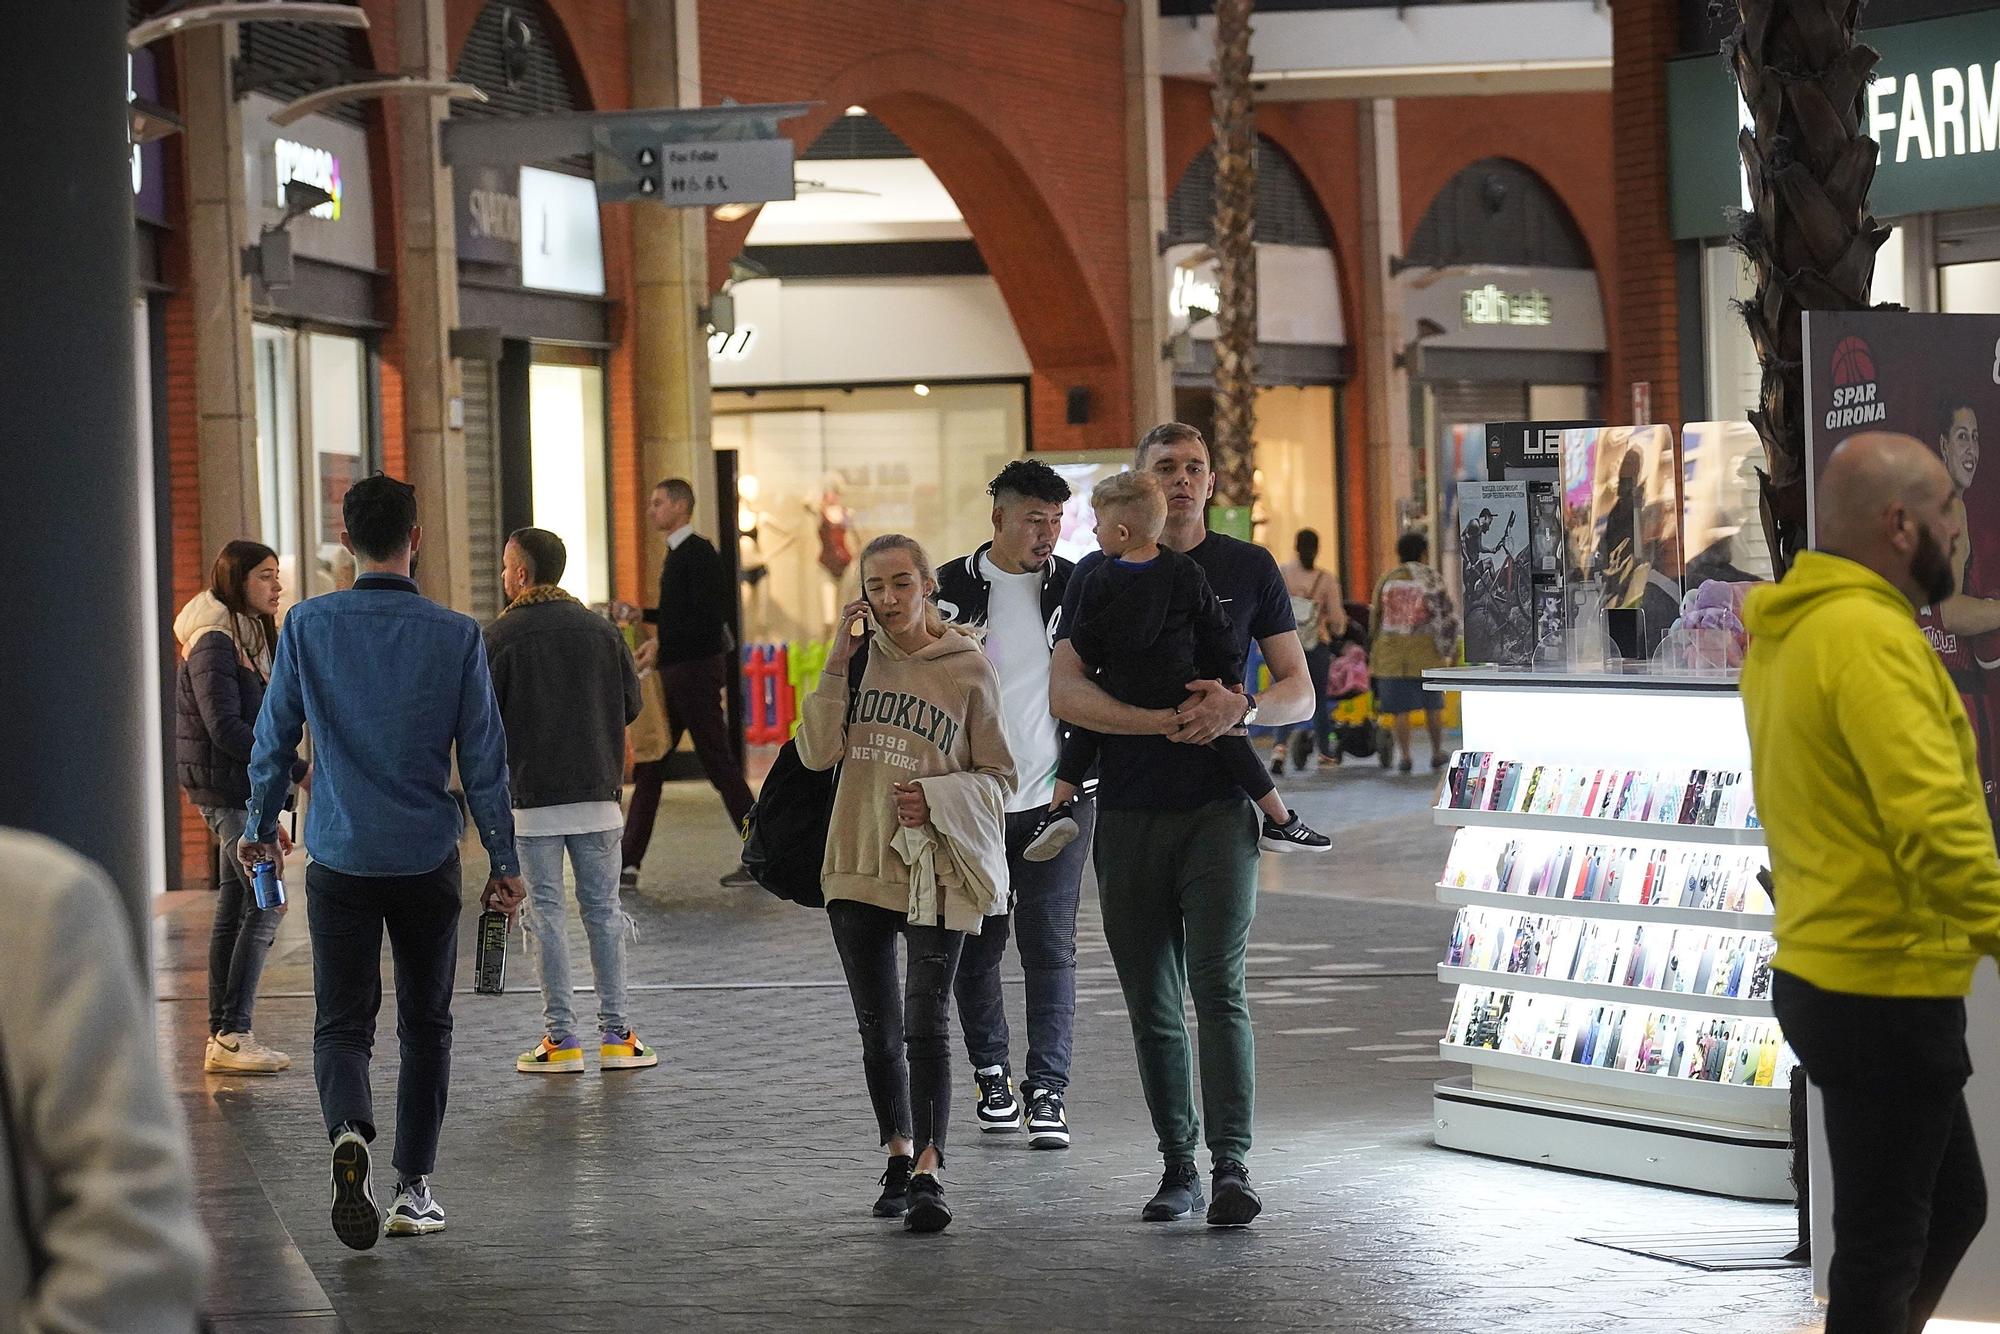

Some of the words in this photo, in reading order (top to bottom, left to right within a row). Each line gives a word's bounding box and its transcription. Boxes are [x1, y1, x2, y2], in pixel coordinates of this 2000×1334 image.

[1867, 60, 2000, 166] FARM
[1833, 383, 1877, 407] SPAR
[1825, 402, 1886, 430] GIRONA
[868, 732, 908, 752] 1898
[851, 746, 880, 761] NEW
[884, 751, 920, 772] YORK
